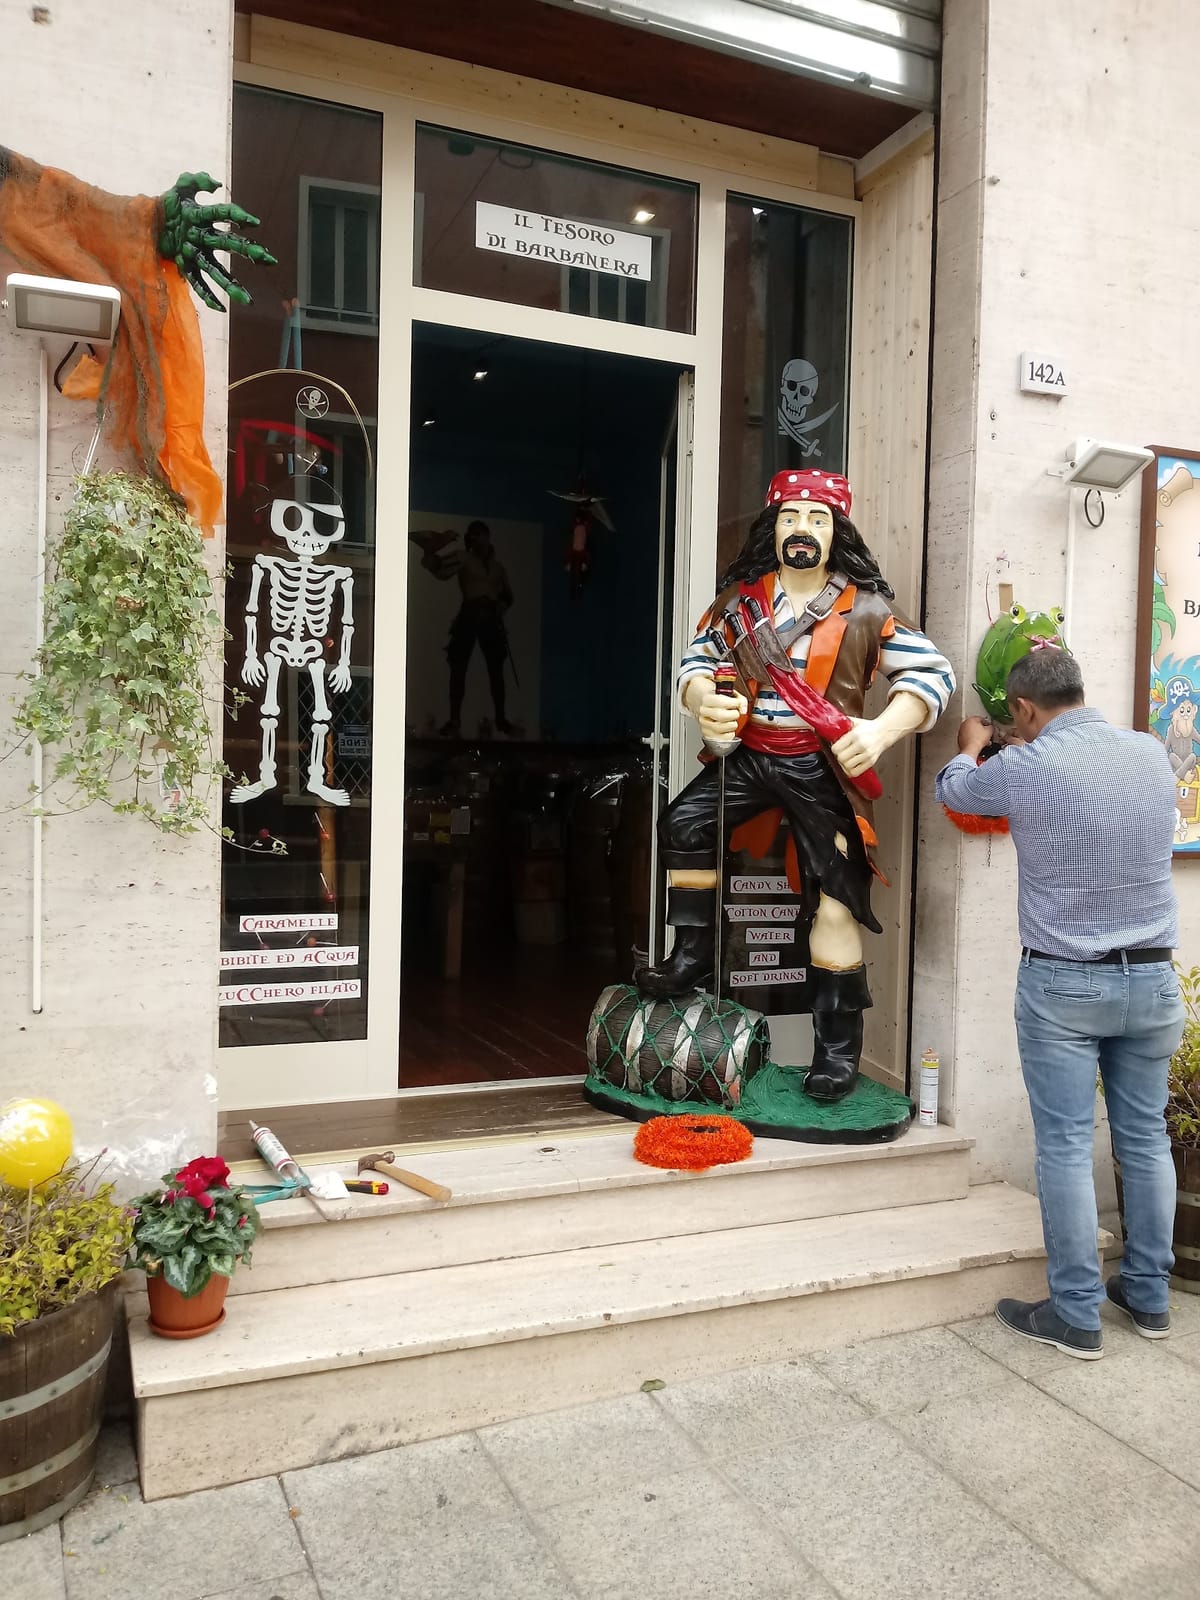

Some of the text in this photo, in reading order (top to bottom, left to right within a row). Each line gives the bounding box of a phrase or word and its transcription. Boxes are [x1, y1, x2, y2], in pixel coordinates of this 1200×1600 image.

[513, 213, 615, 247] IL TESORO
[487, 232, 639, 276] DI BARBANERA
[1029, 361, 1066, 386] 142A
[733, 880, 772, 892] CANDY
[727, 907, 768, 919] COTTON
[242, 917, 335, 932] CARAMELLE
[748, 930, 792, 941] WATER
[221, 950, 356, 966] BIBITE ED ACQUA
[752, 953, 777, 963] AND
[732, 970, 805, 985] SOFT DRINKS
[311, 983, 359, 994] FILATO
